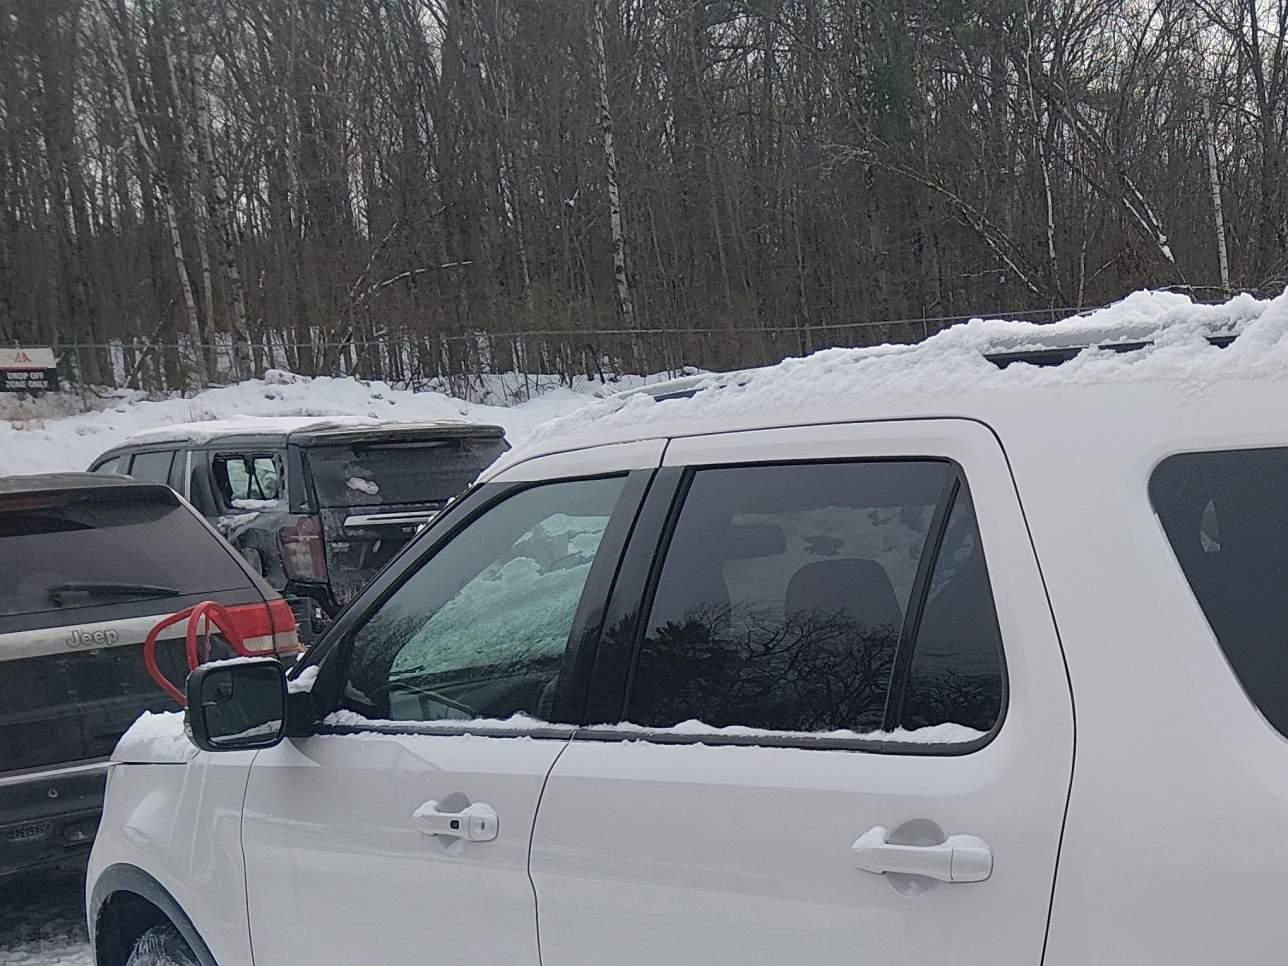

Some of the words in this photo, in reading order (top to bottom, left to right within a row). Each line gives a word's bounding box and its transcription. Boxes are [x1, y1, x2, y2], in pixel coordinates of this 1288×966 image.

[30, 372, 44, 380] OFF
[6, 380, 27, 389] ZONE
[28, 380, 48, 388] ONLY
[65, 630, 119, 648] Jeep
